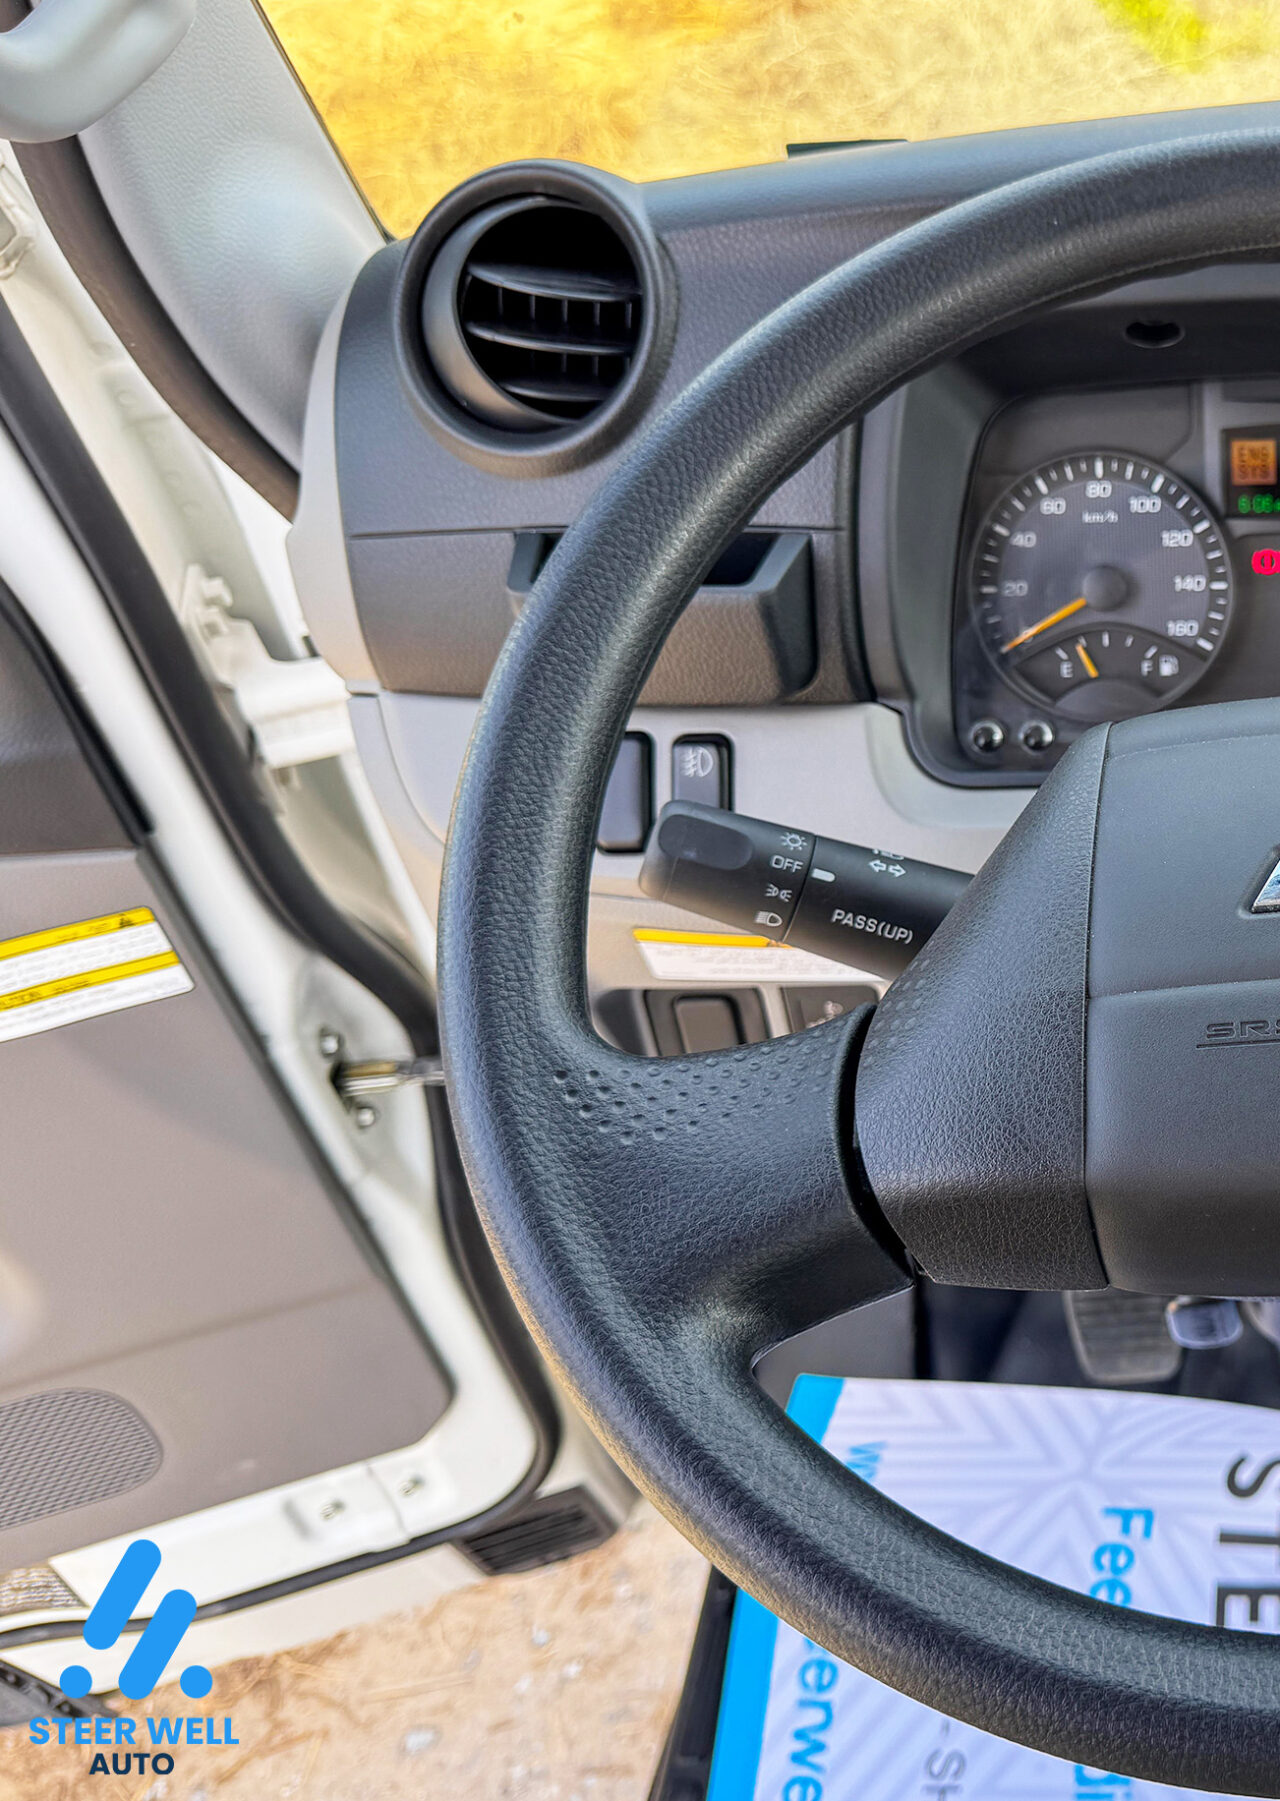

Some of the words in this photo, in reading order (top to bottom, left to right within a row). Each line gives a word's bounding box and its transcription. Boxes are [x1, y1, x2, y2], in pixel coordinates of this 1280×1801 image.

[1086, 481, 1112, 497] 80
[1040, 499, 1066, 514] 60
[1130, 497, 1162, 512] 100
[1010, 532, 1037, 548] 40
[1161, 530, 1194, 547] 120
[1003, 580, 1028, 597] 20
[1174, 575, 1206, 592] 140
[1166, 620, 1198, 637] 160
[1060, 661, 1073, 678] E
[1141, 660, 1152, 676] F
[770, 855, 804, 874] OFF
[830, 907, 914, 944] PASS(UP)
